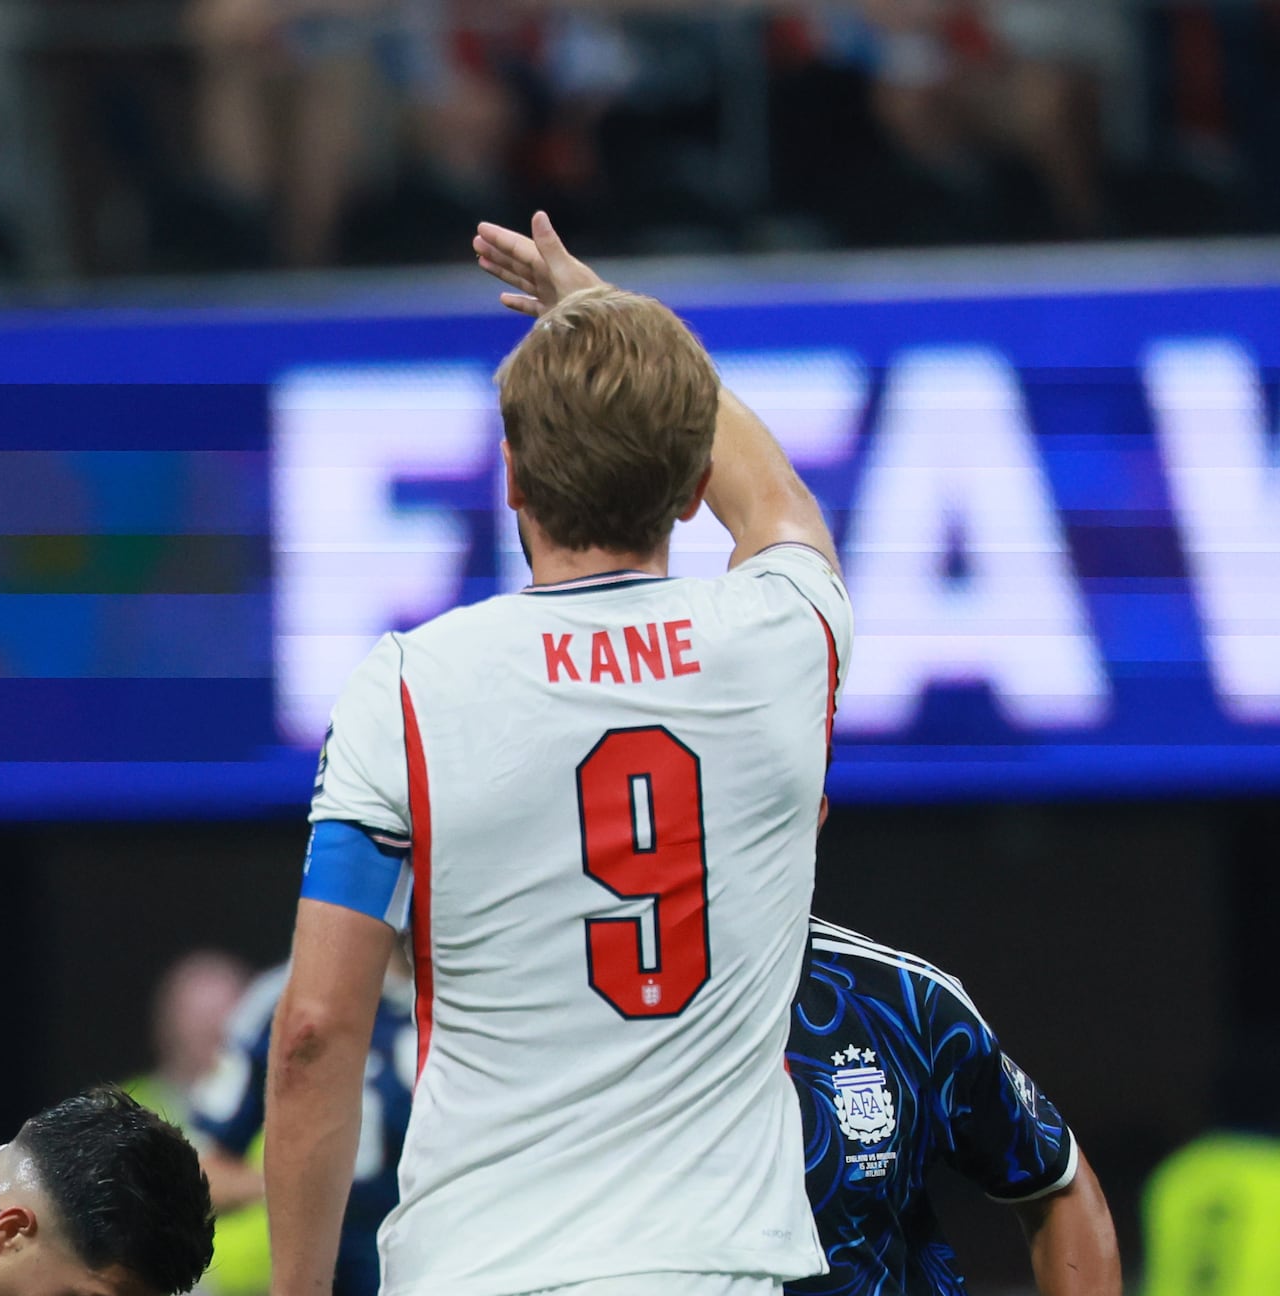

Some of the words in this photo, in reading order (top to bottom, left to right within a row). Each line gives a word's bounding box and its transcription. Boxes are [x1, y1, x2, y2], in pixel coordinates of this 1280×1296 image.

[266, 342, 1116, 750] FA
[542, 618, 702, 684] KANE
[576, 724, 709, 1019] 9
[850, 1087, 883, 1120] AFA
